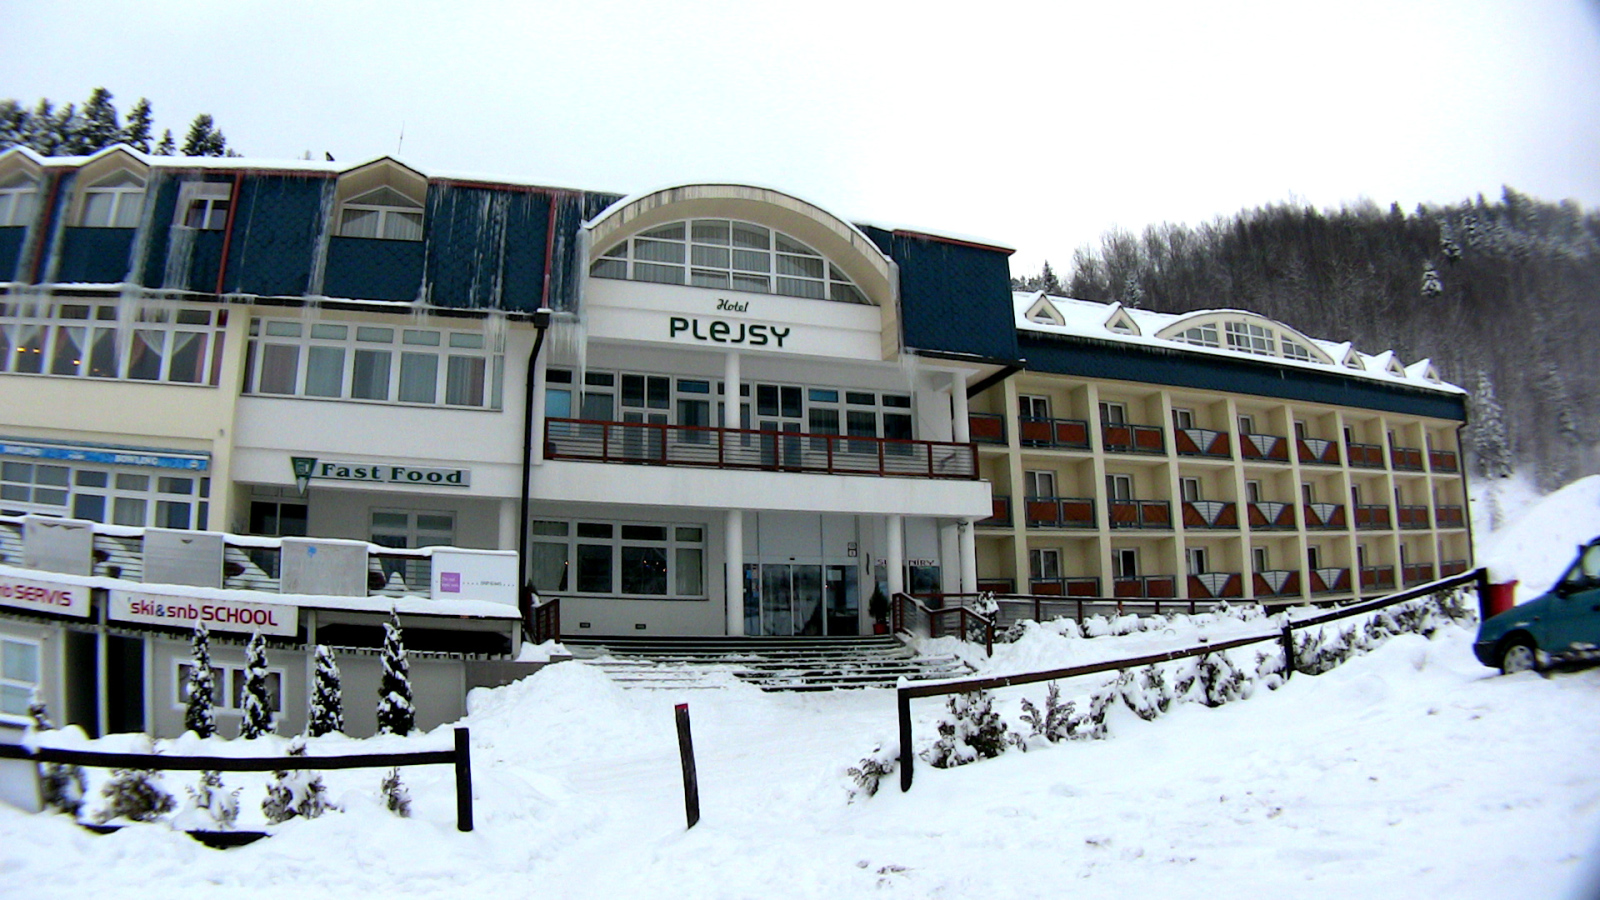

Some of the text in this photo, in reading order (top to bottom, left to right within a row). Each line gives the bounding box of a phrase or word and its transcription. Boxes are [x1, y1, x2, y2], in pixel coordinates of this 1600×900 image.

[717, 299, 749, 312] Hotel
[321, 463, 462, 483] Fast Food
[14, 585, 72, 607] SERVIS
[201, 605, 279, 627] SCHOOL
